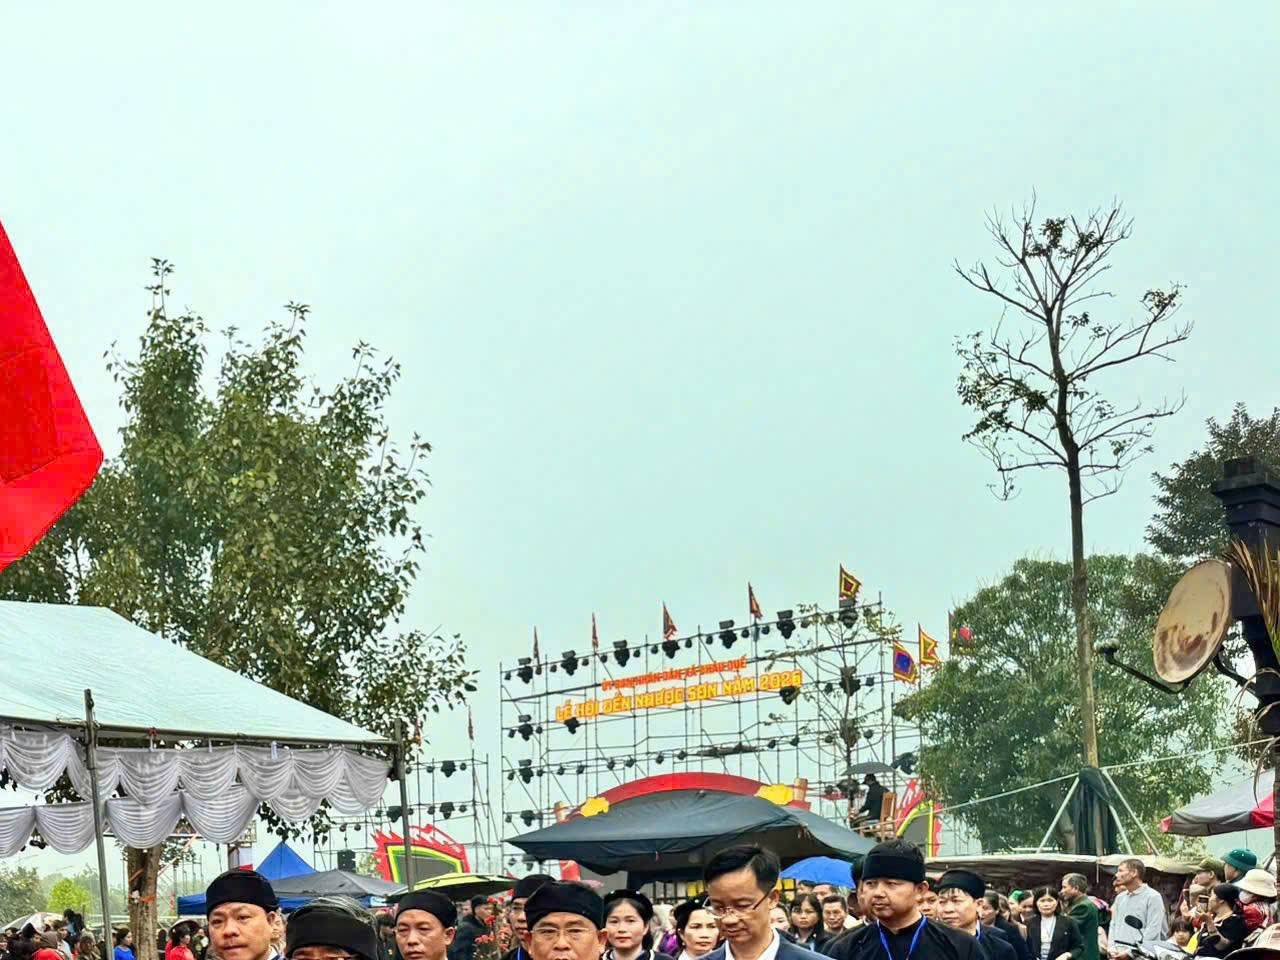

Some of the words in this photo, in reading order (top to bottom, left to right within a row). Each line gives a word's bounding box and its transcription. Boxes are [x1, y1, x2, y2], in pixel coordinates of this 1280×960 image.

[576, 699, 599, 719] HỘI
[687, 681, 718, 701] SƠN
[722, 675, 756, 696] NĂM
[759, 669, 803, 691] 2026
